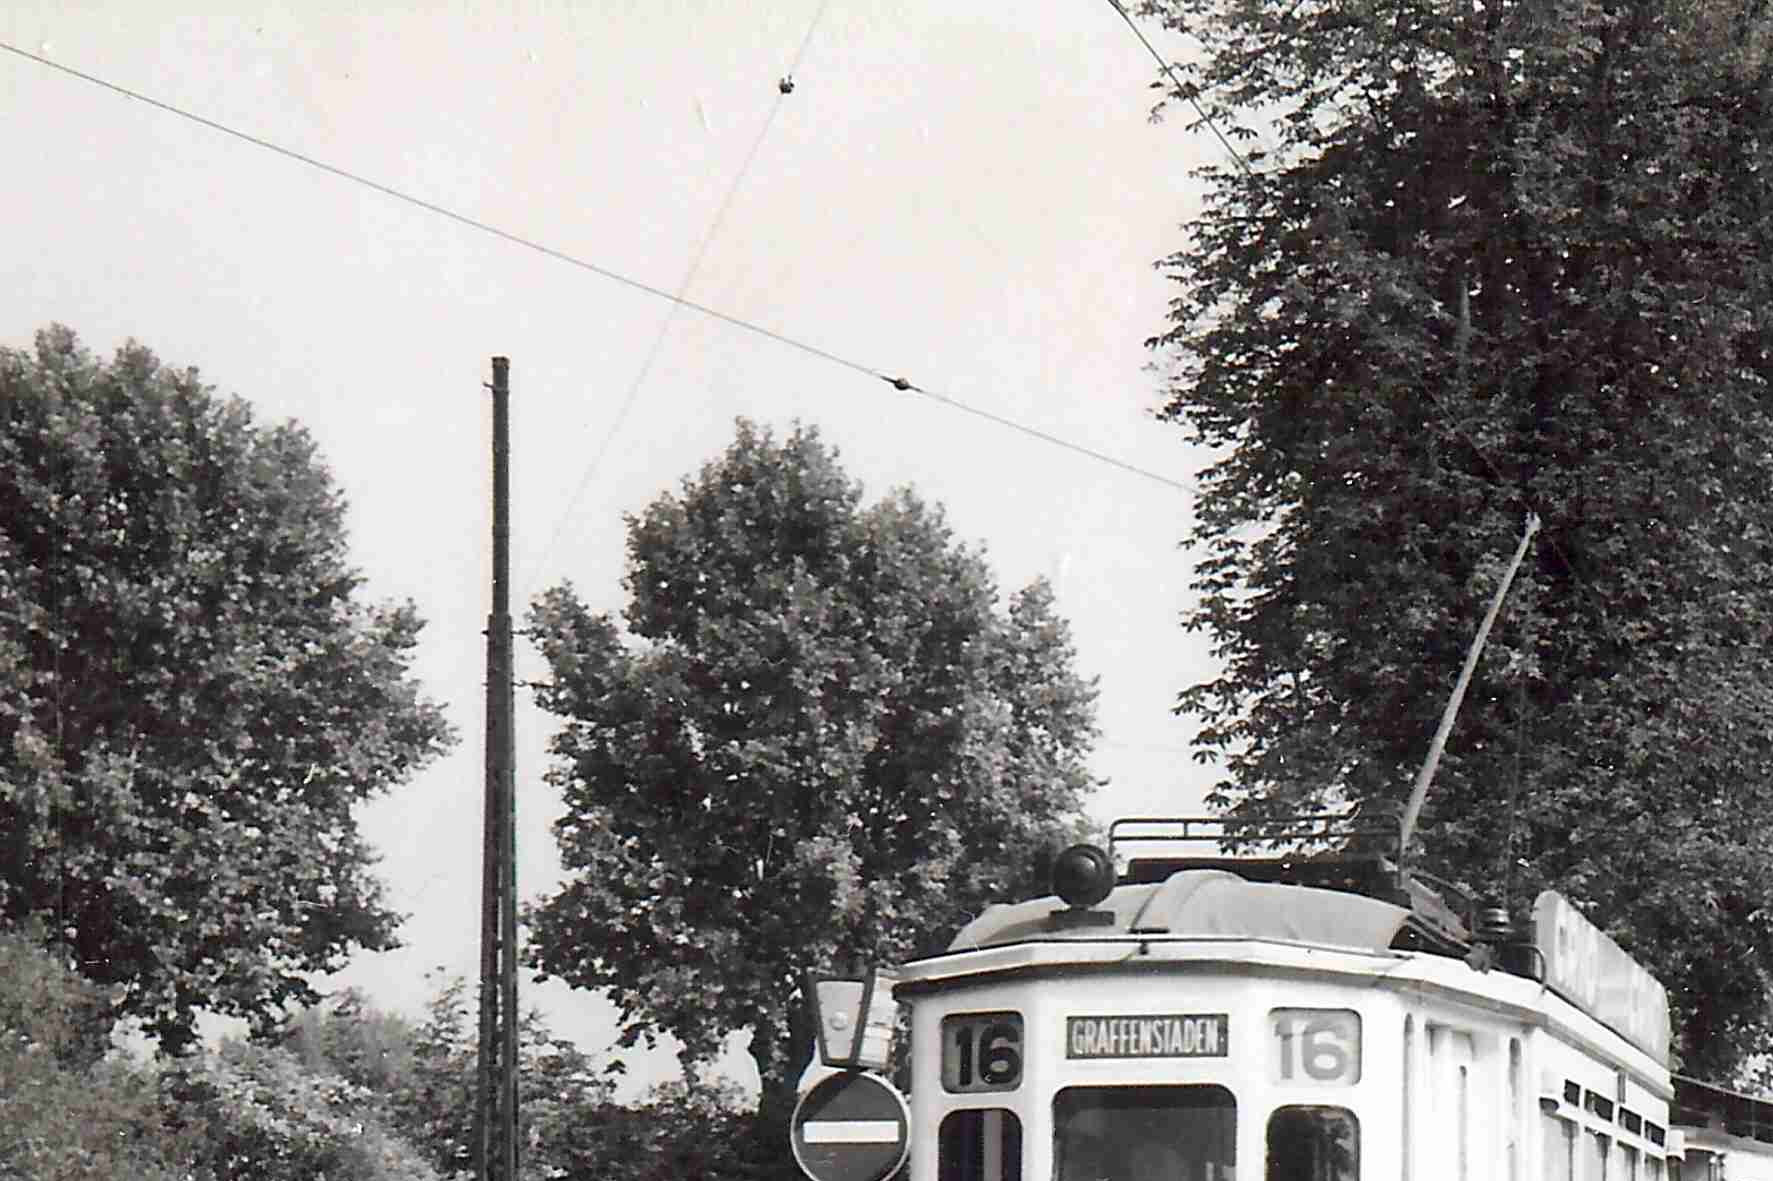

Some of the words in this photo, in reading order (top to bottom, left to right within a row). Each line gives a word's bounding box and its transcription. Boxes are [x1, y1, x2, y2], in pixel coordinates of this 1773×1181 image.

[955, 1021, 1022, 1086] 16
[1071, 1018, 1219, 1055] GRAFFENSTADEN
[1273, 1020, 1349, 1081] 16
